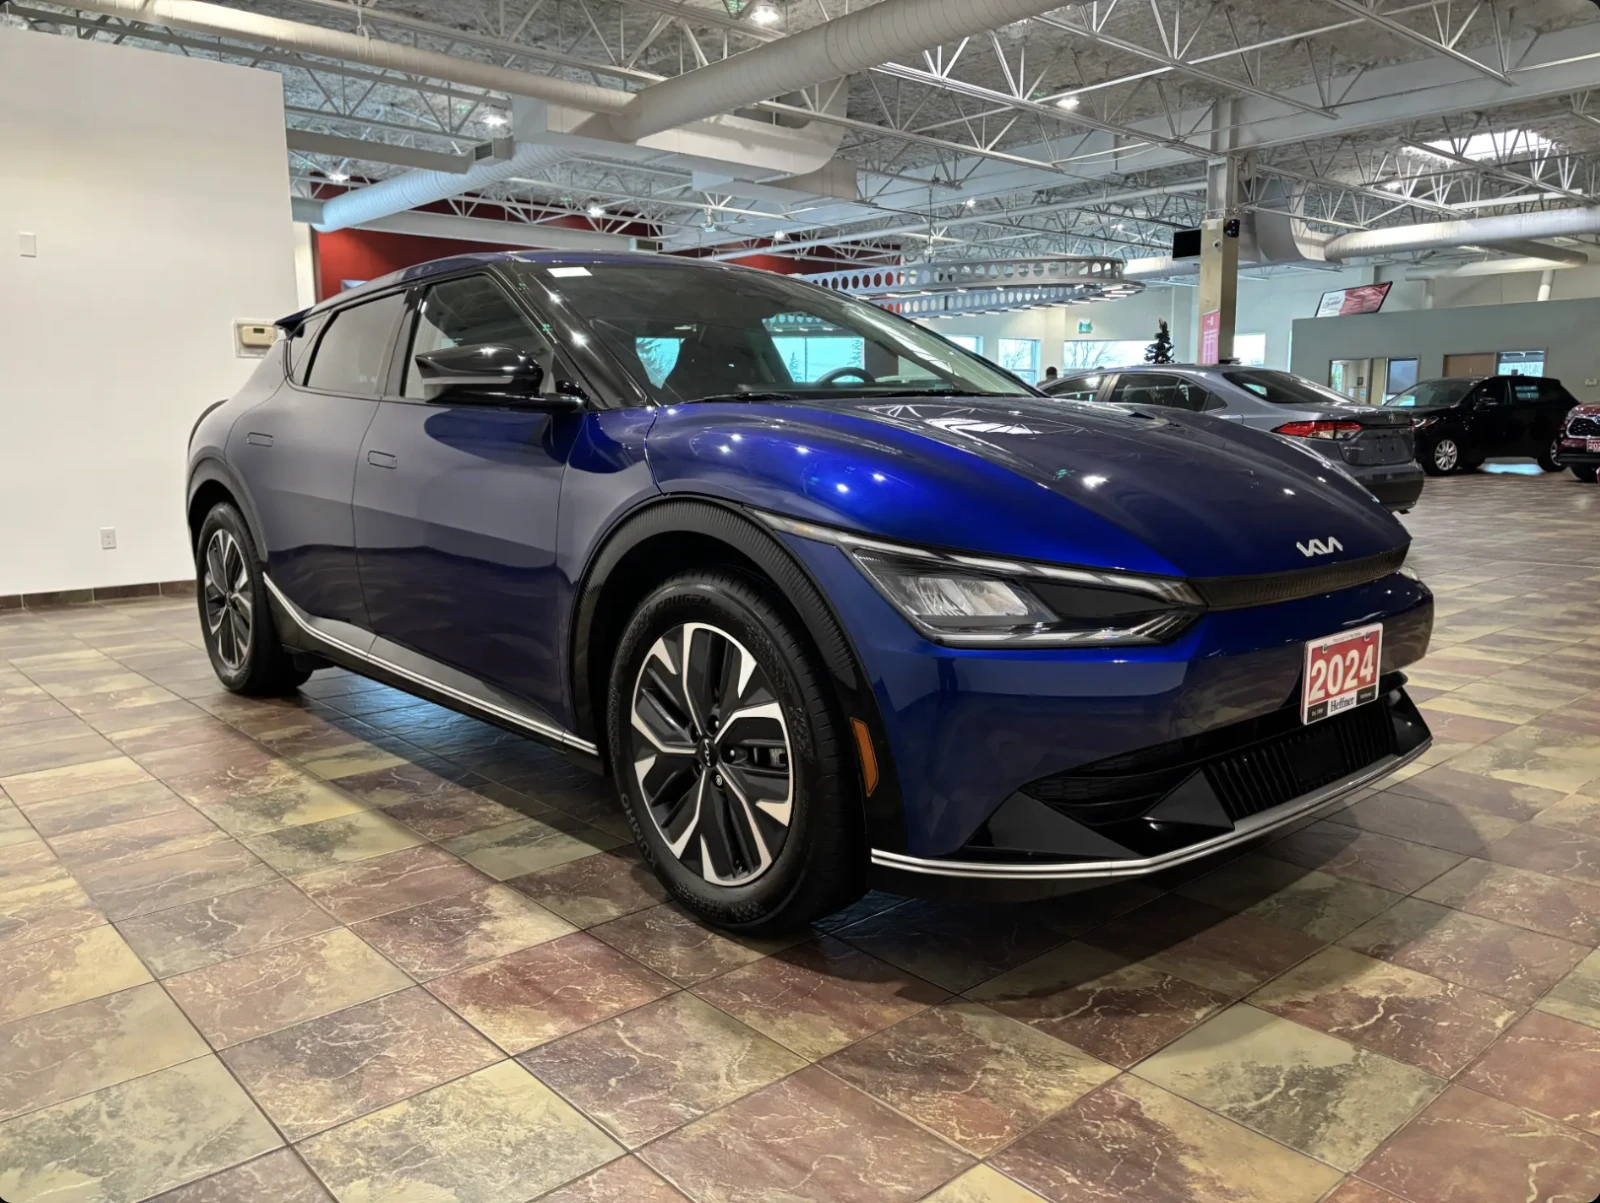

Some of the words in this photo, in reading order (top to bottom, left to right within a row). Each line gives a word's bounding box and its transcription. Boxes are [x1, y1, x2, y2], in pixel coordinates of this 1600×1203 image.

[1296, 536, 1343, 557] KIA
[1309, 644, 1374, 701] 2024
[1330, 697, 1355, 713] Heffner
